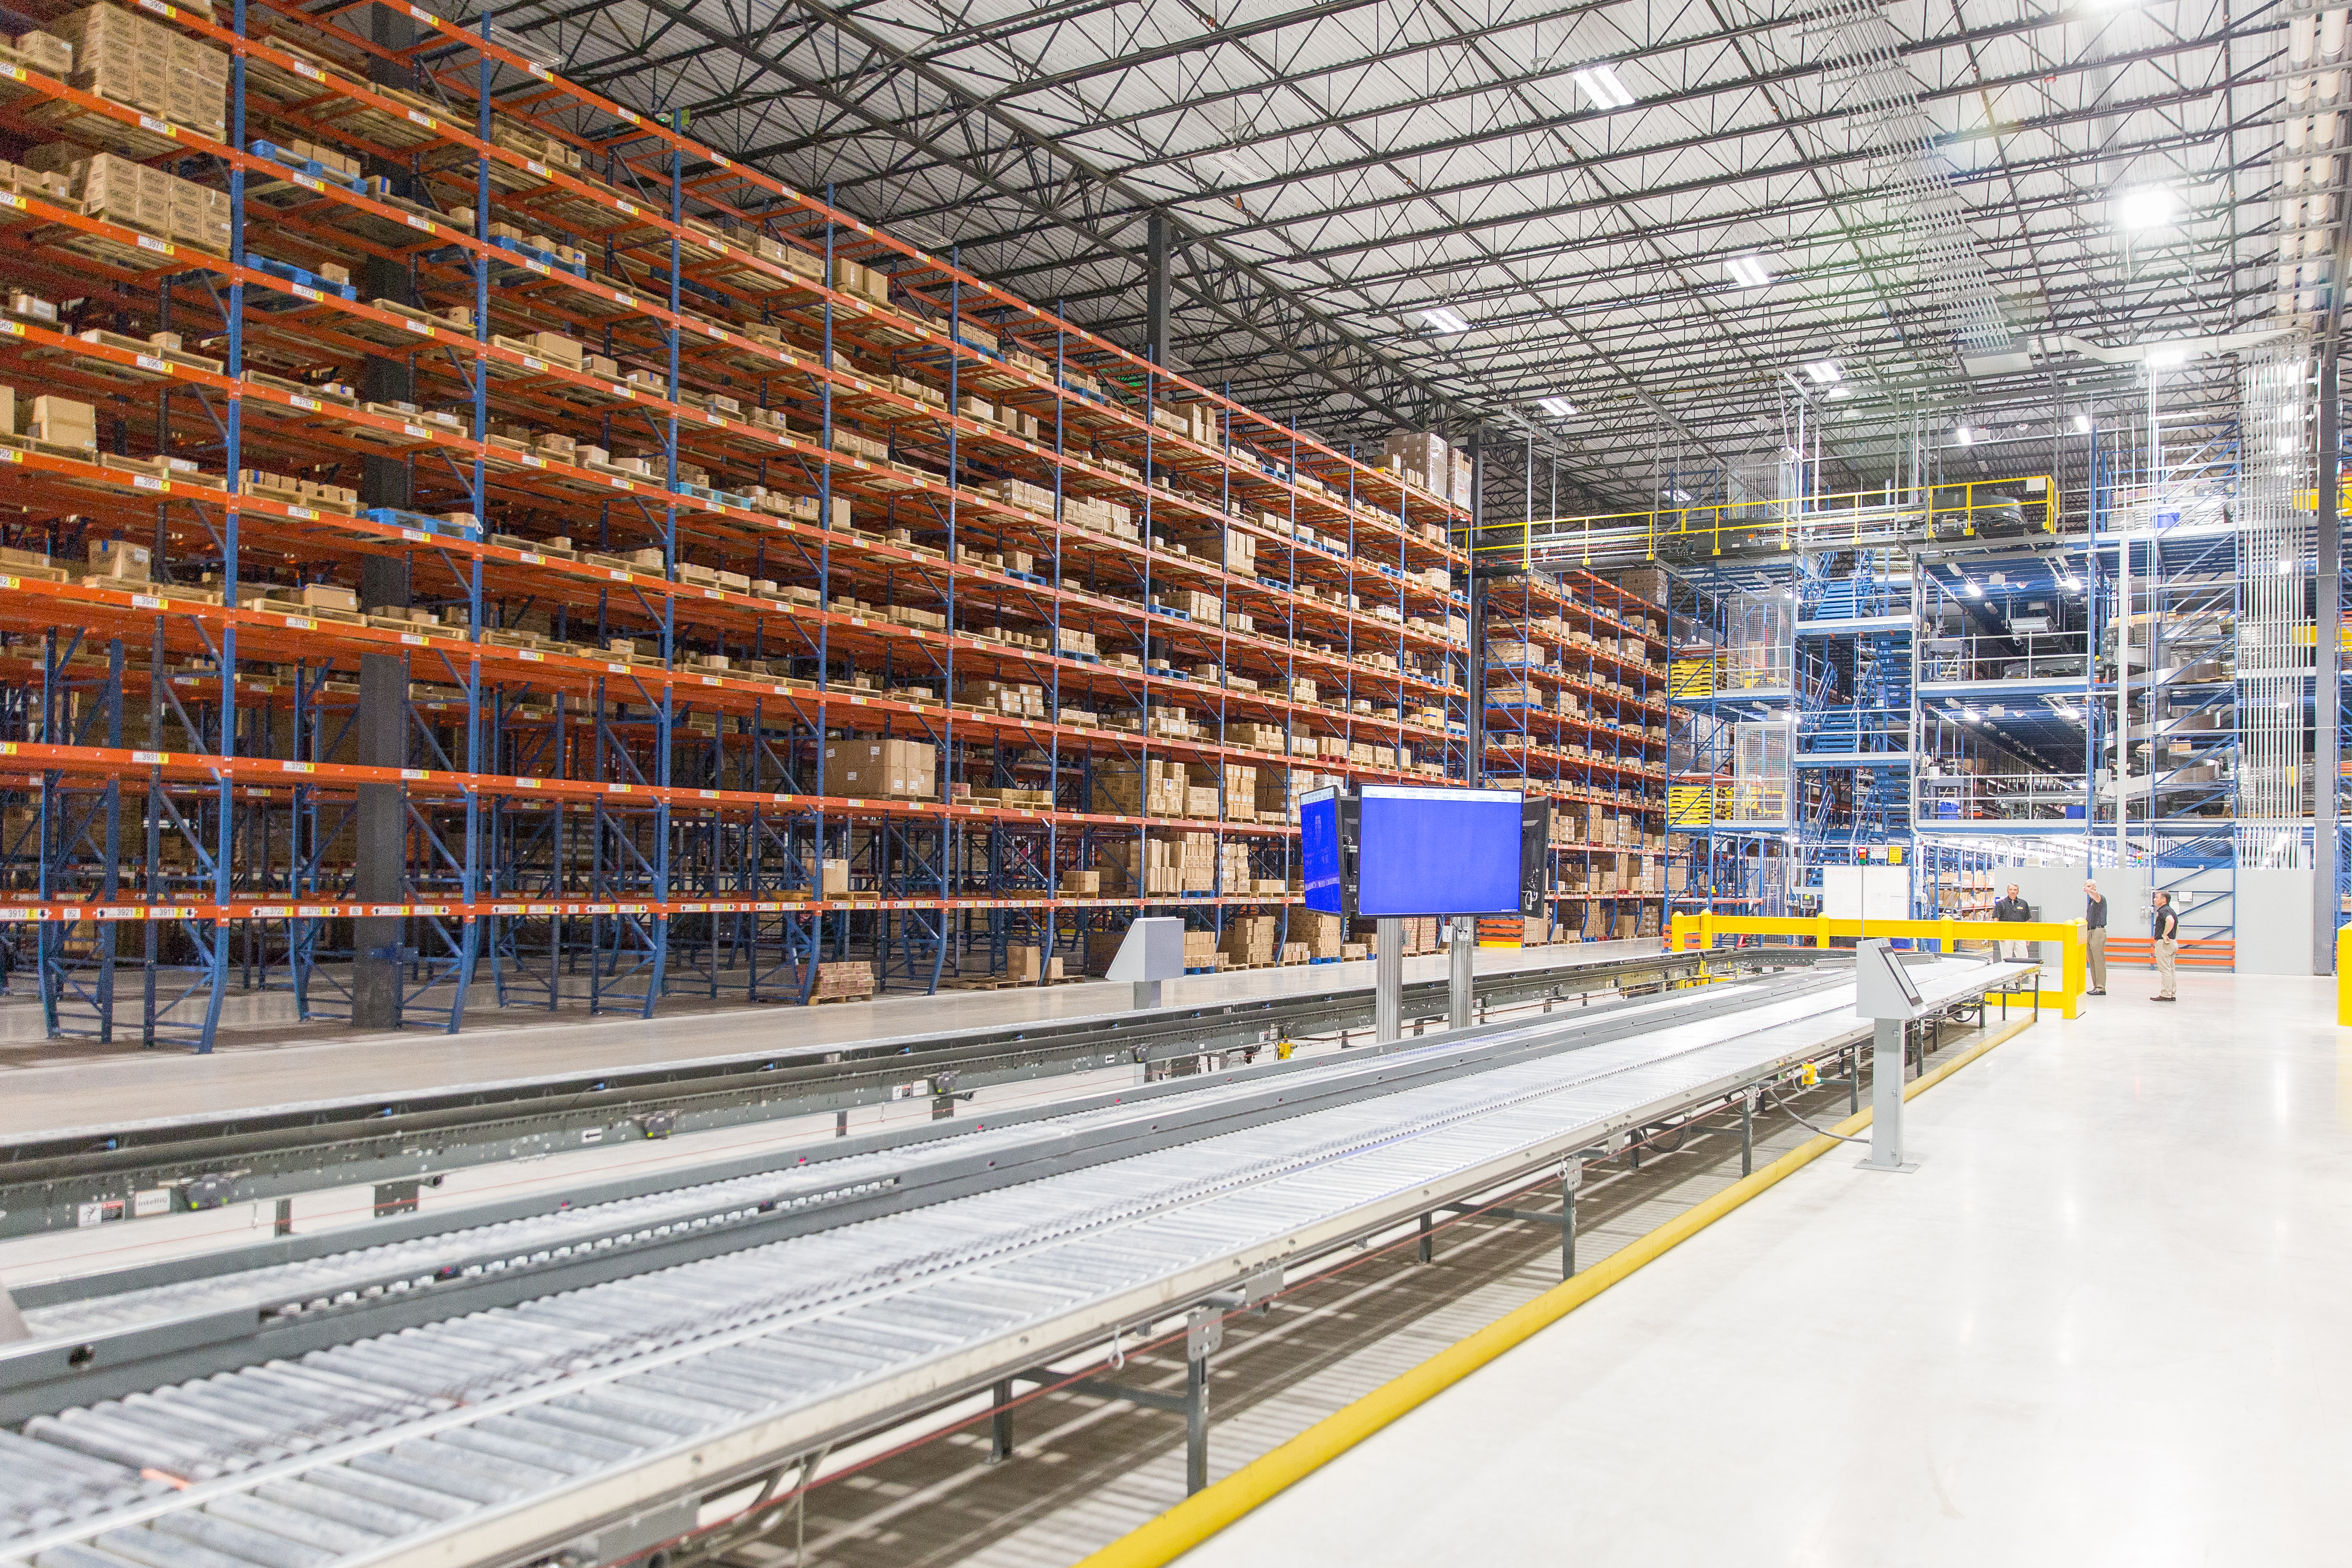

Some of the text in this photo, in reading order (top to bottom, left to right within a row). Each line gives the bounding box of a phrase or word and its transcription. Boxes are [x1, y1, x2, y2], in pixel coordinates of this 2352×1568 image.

[149, 0, 165, 12] 3991
[302, 65, 316, 77] 3792
[416, 114, 428, 124] 3791
[149, 119, 173, 134] 3981 P
[535, 164, 545, 174] 3592
[302, 176, 315, 187] 3782
[415, 218, 427, 228] 3781
[148, 239, 163, 250] 3971
[301, 286, 314, 297] 3772
[414, 323, 426, 332] 3771
[146, 358, 162, 369] 3961
[530, 359, 541, 368] 3572
[619, 387, 629, 396] 3571
[299, 397, 312, 407] 3762
[412, 427, 424, 436] 3761
[529, 457, 539, 465] 3562
[144, 478, 159, 488] 3951
[296, 508, 310, 517] 3752
[410, 531, 422, 539] 3751
[142, 597, 157, 606] 3941
[142, 753, 158, 761] 3931
